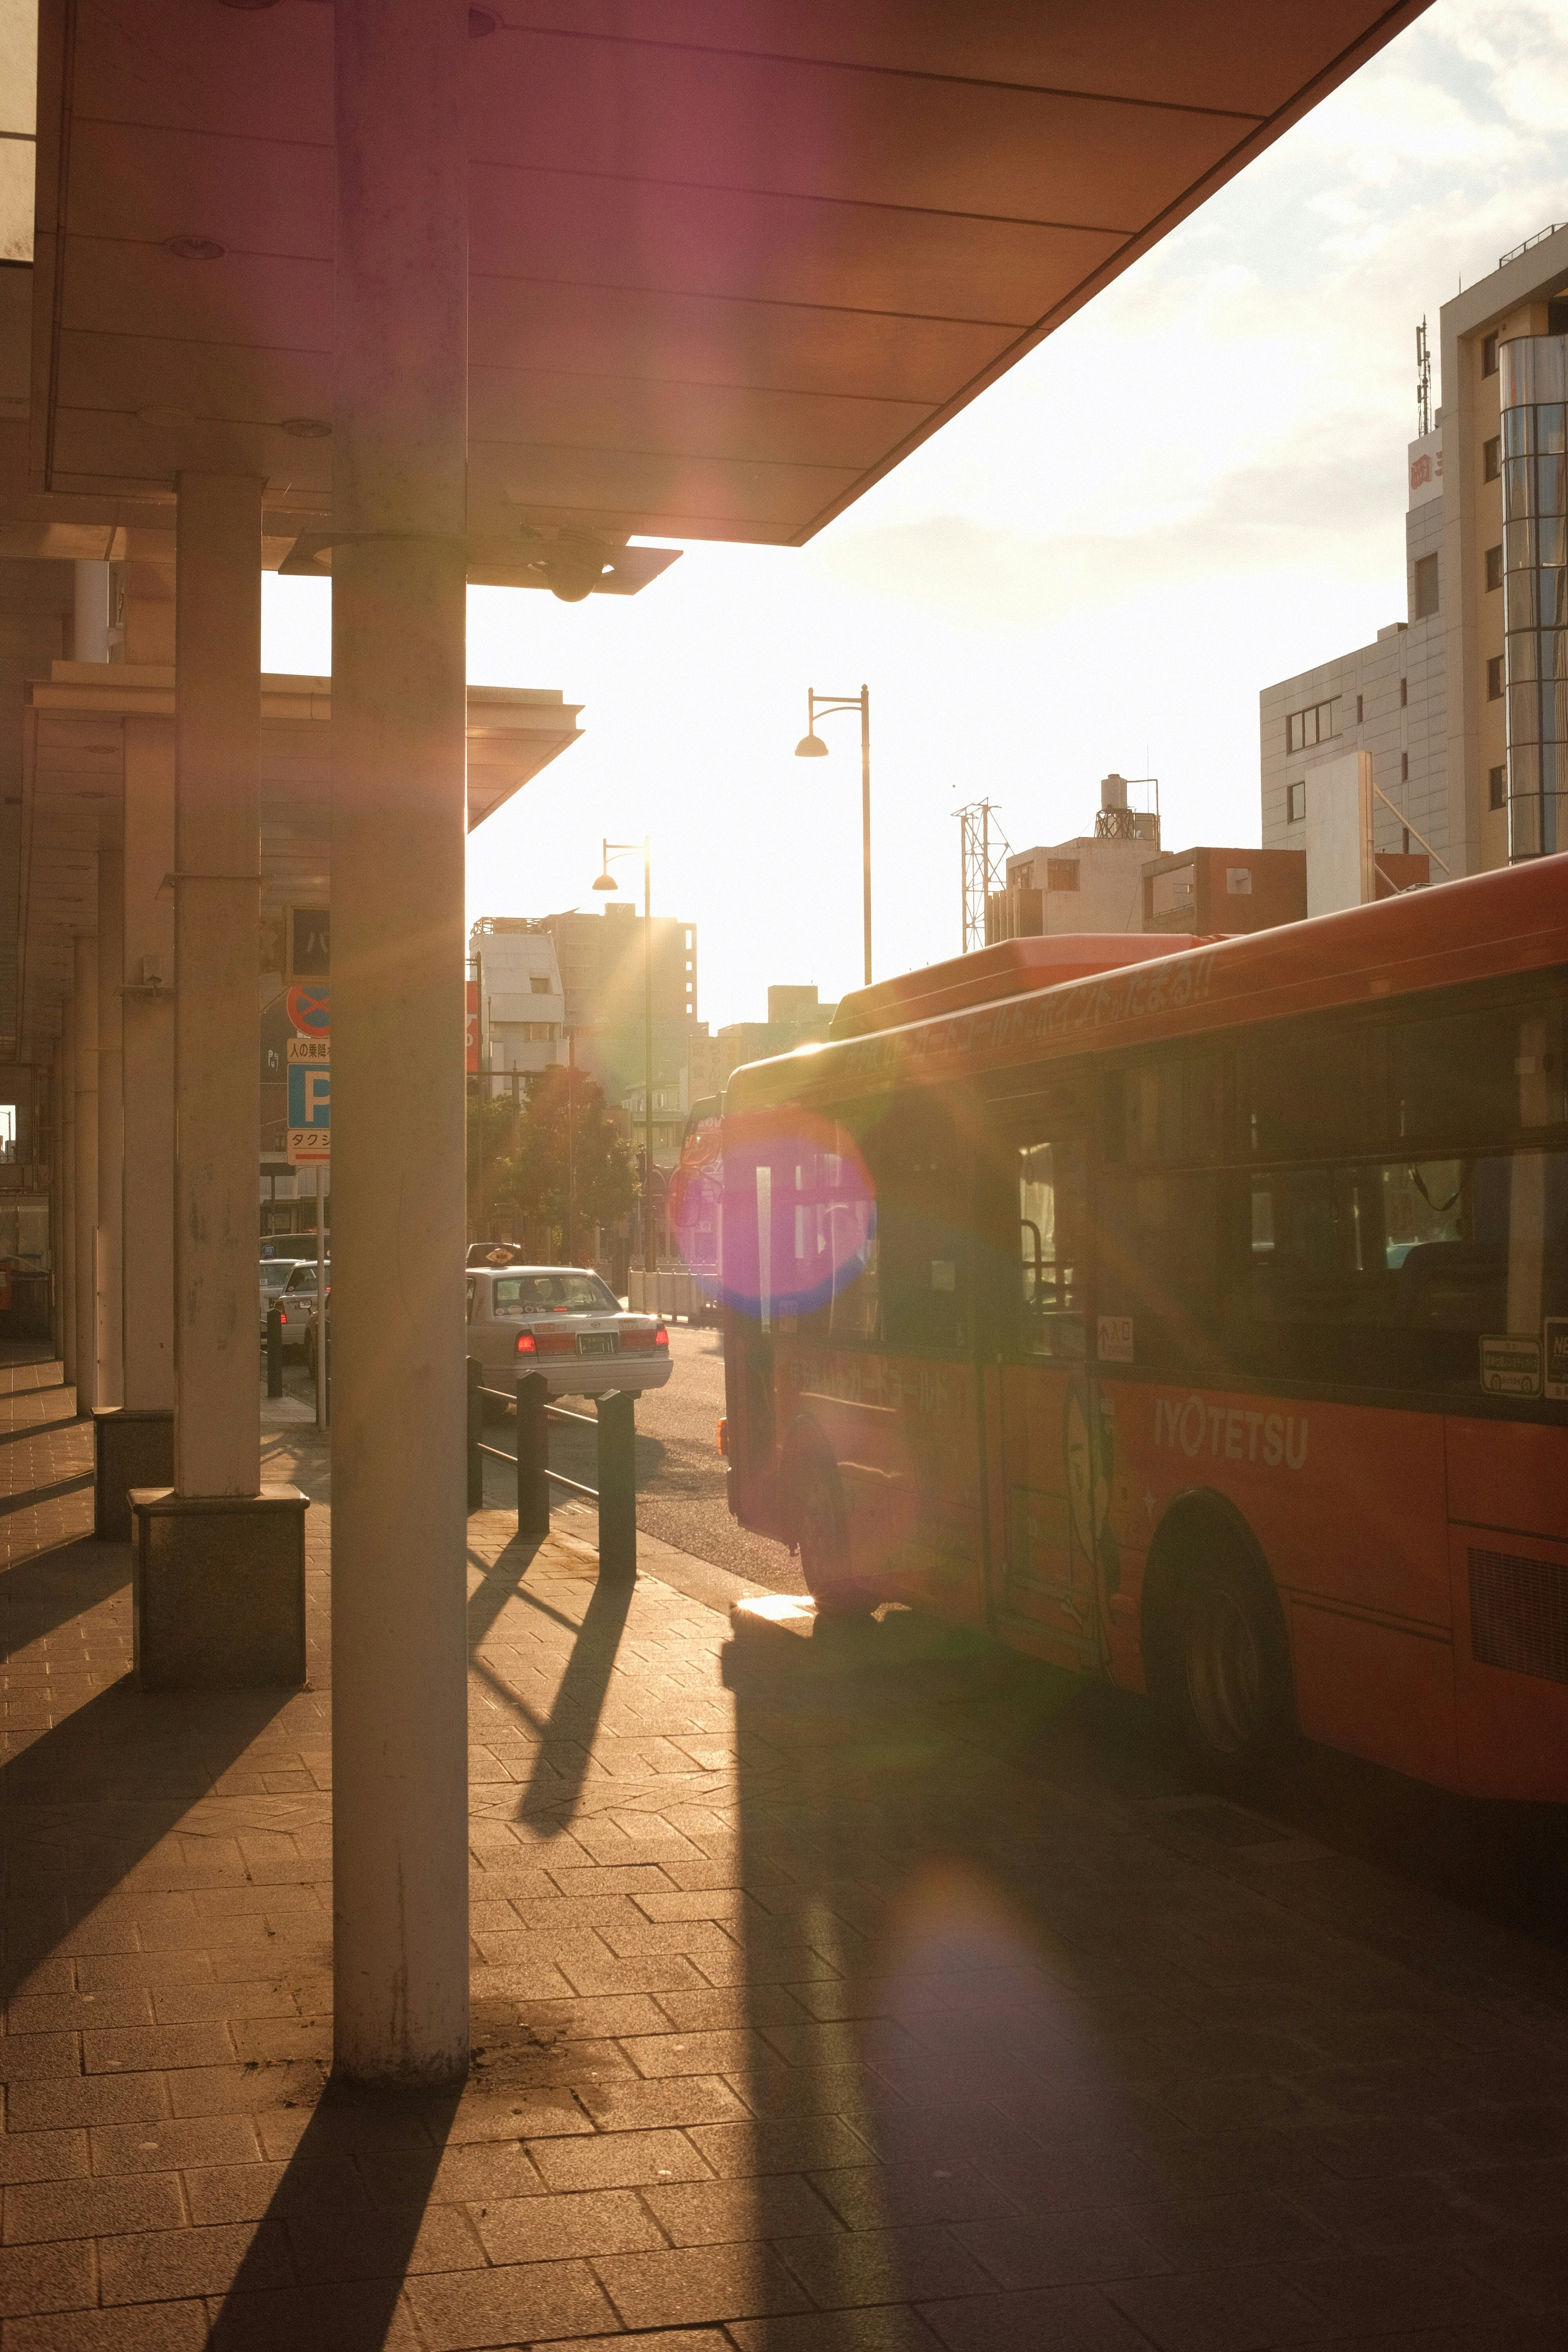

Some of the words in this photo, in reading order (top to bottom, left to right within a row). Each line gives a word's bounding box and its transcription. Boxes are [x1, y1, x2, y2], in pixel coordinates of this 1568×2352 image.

[305, 1071, 330, 1121] P
[1111, 1320, 1131, 1341] 入口
[1153, 1395, 1309, 1470] IYOTETSU
